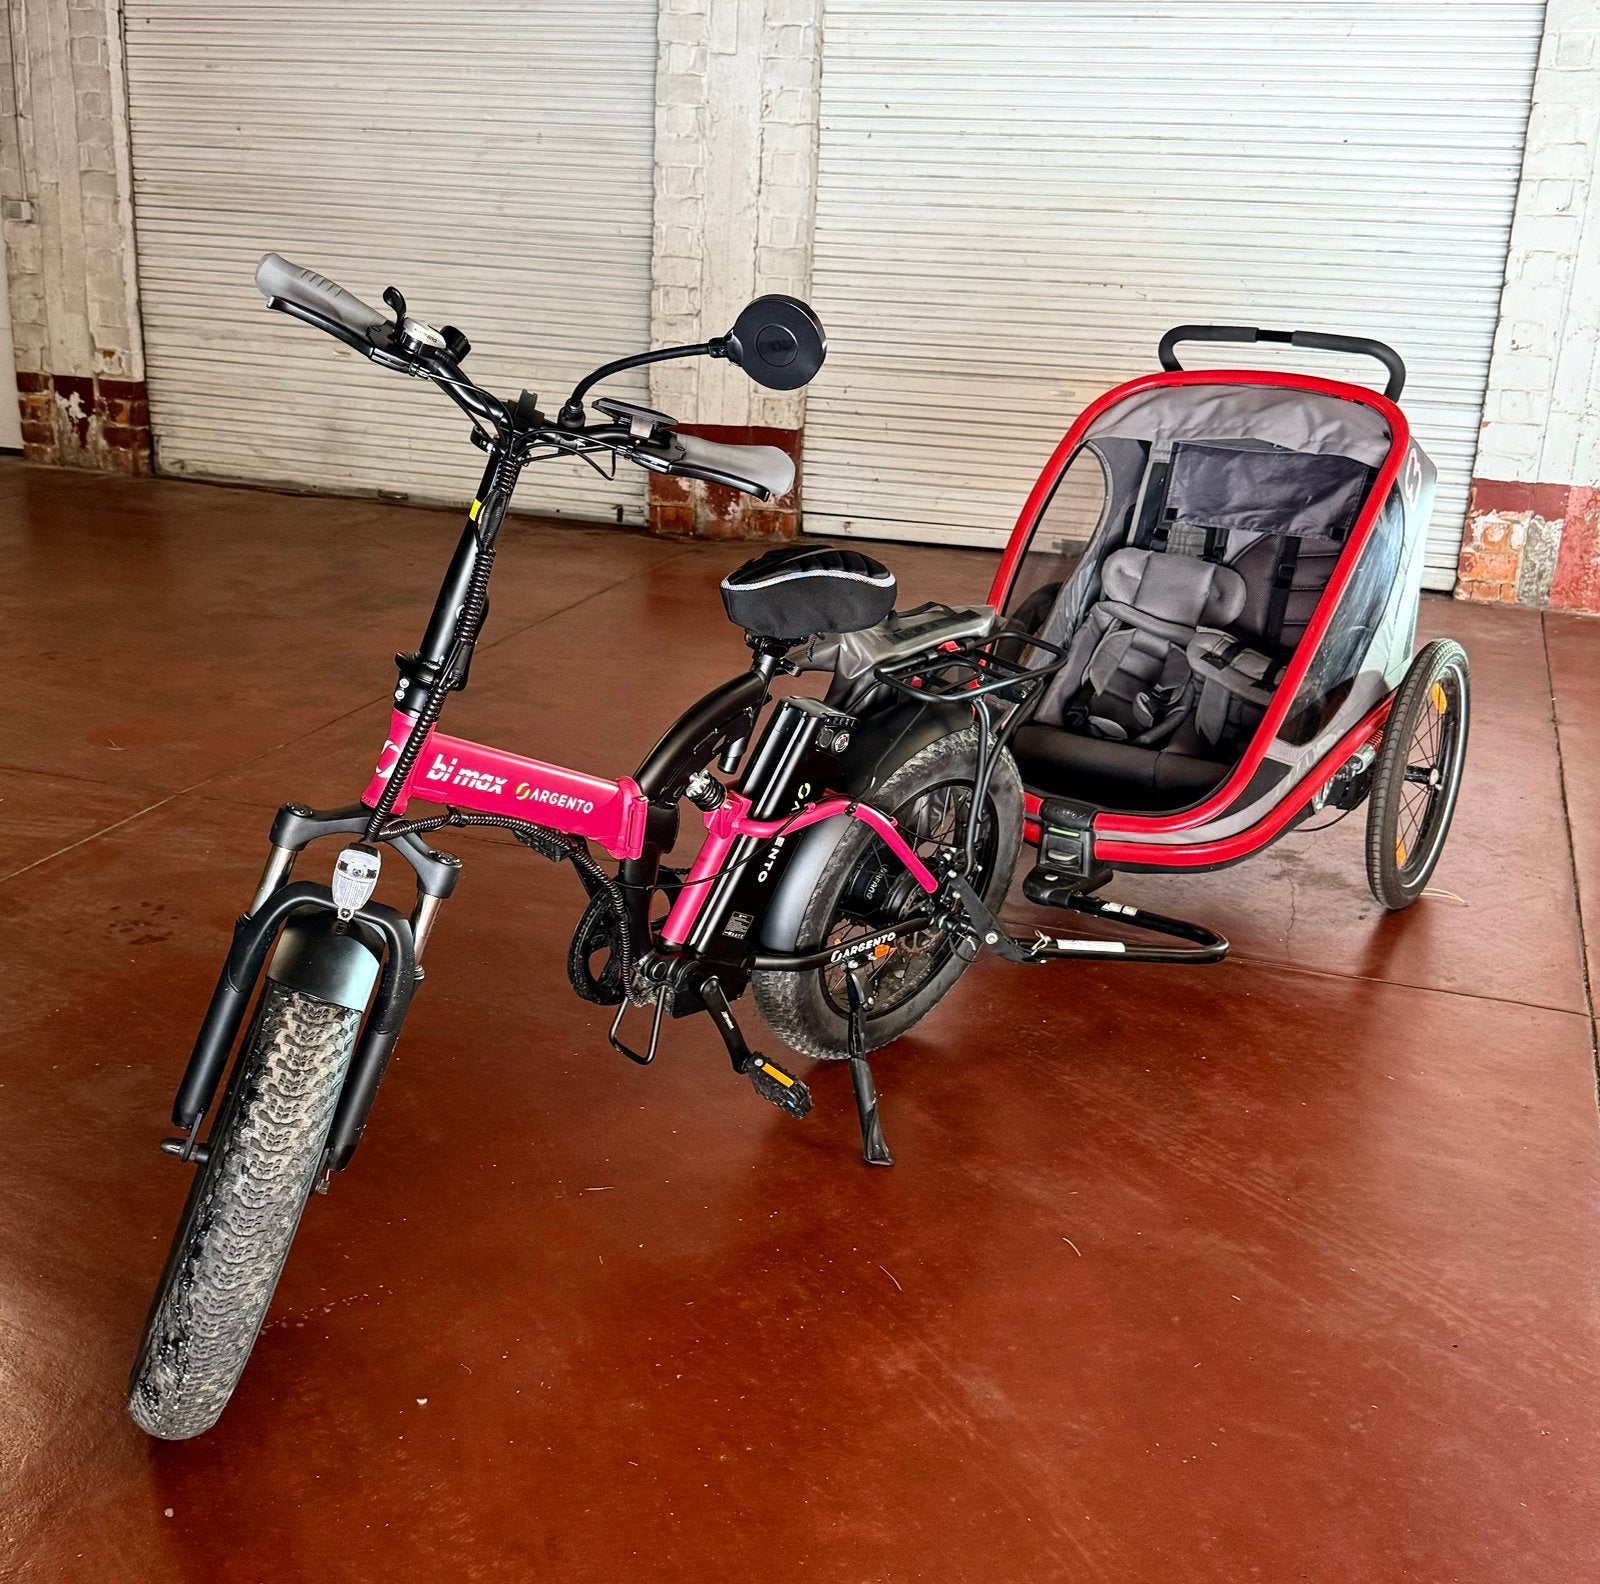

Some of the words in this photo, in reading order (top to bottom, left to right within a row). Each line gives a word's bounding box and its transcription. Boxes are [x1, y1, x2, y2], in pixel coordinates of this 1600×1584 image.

[426, 754, 458, 782] bi
[453, 768, 508, 794] max
[530, 788, 594, 814] ARGENTO
[757, 801, 801, 882] AENTO
[842, 932, 896, 958] ARGENTO
